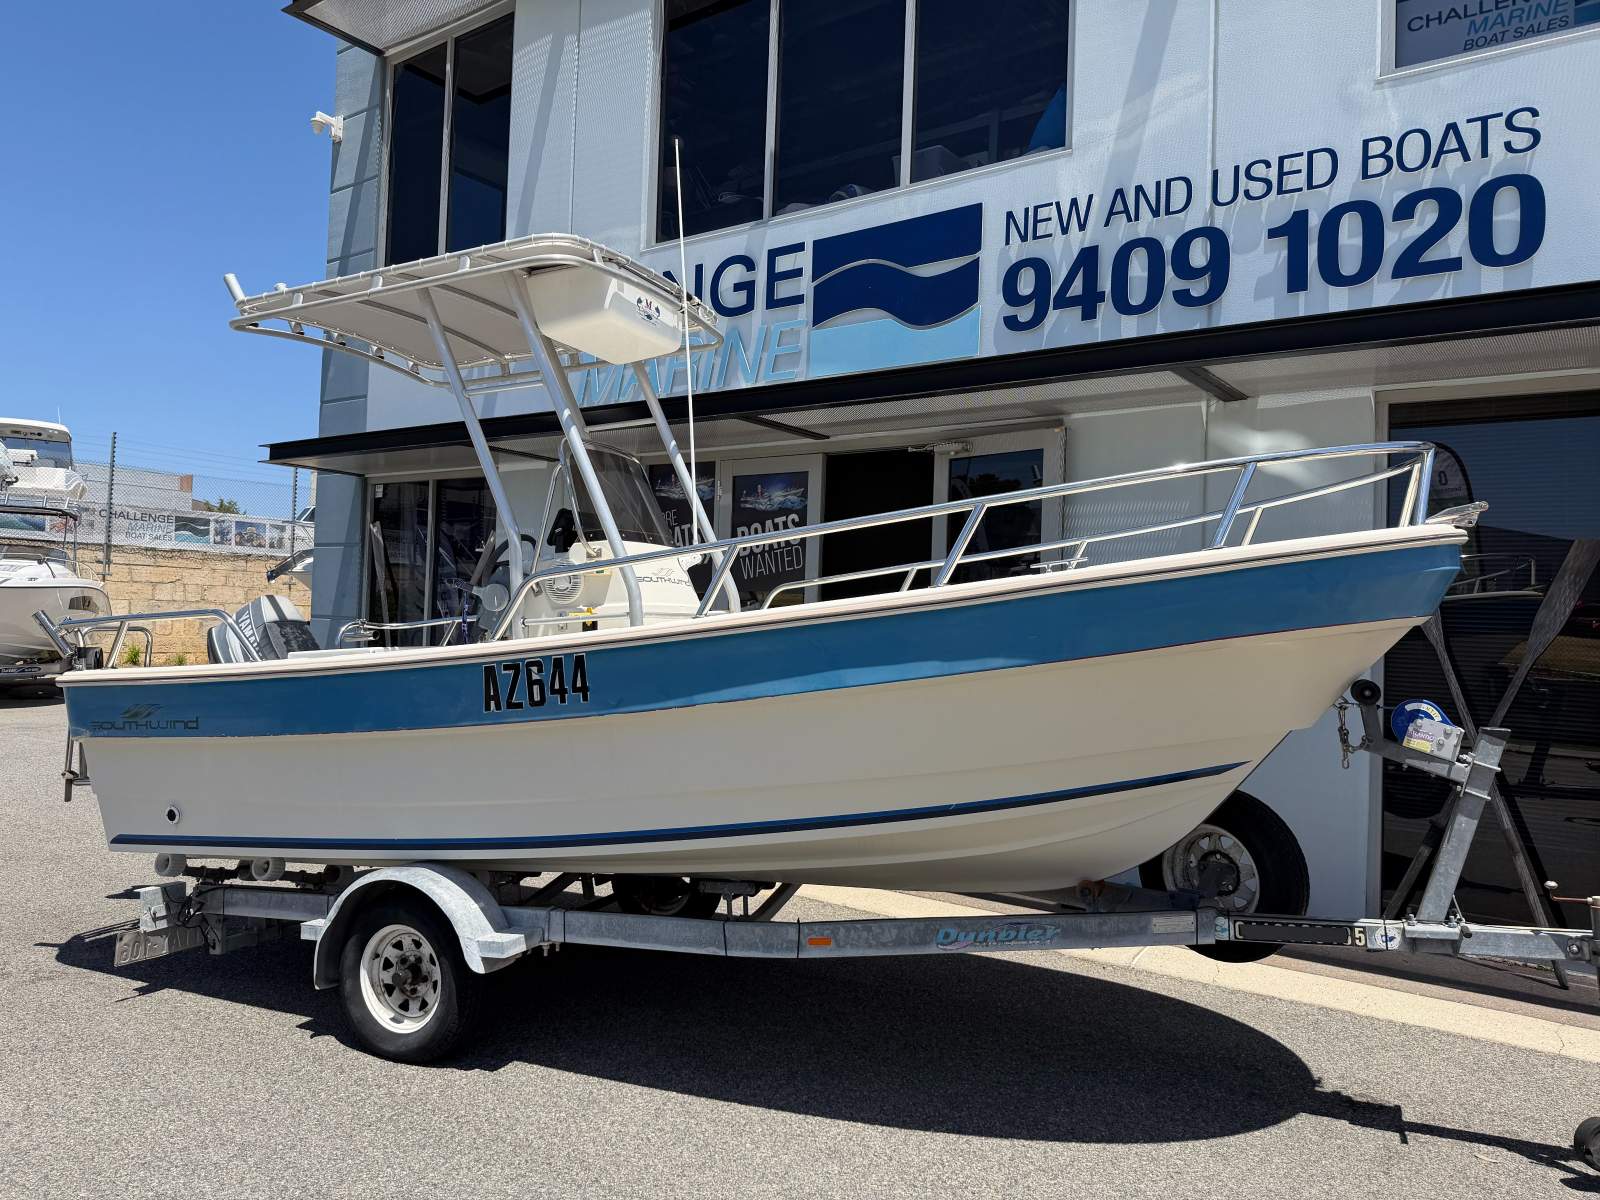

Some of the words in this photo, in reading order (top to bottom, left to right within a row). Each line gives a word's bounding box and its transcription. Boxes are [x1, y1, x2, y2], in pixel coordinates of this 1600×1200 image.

[1407, 0, 1531, 32] CHALLE
[1463, 31, 1506, 51] BOAT
[1512, 15, 1570, 39] SALES
[1466, 0, 1569, 36] MARINE
[1004, 193, 1094, 246] NEW
[1103, 176, 1193, 228] AND
[1211, 147, 1339, 207] USED
[1361, 106, 1542, 181] BOATS
[1001, 226, 1231, 332] 9409
[1267, 173, 1546, 294] 1020
[737, 513, 801, 557] BOATS
[740, 545, 803, 580] WANTED
[482, 652, 590, 713] AZ644
